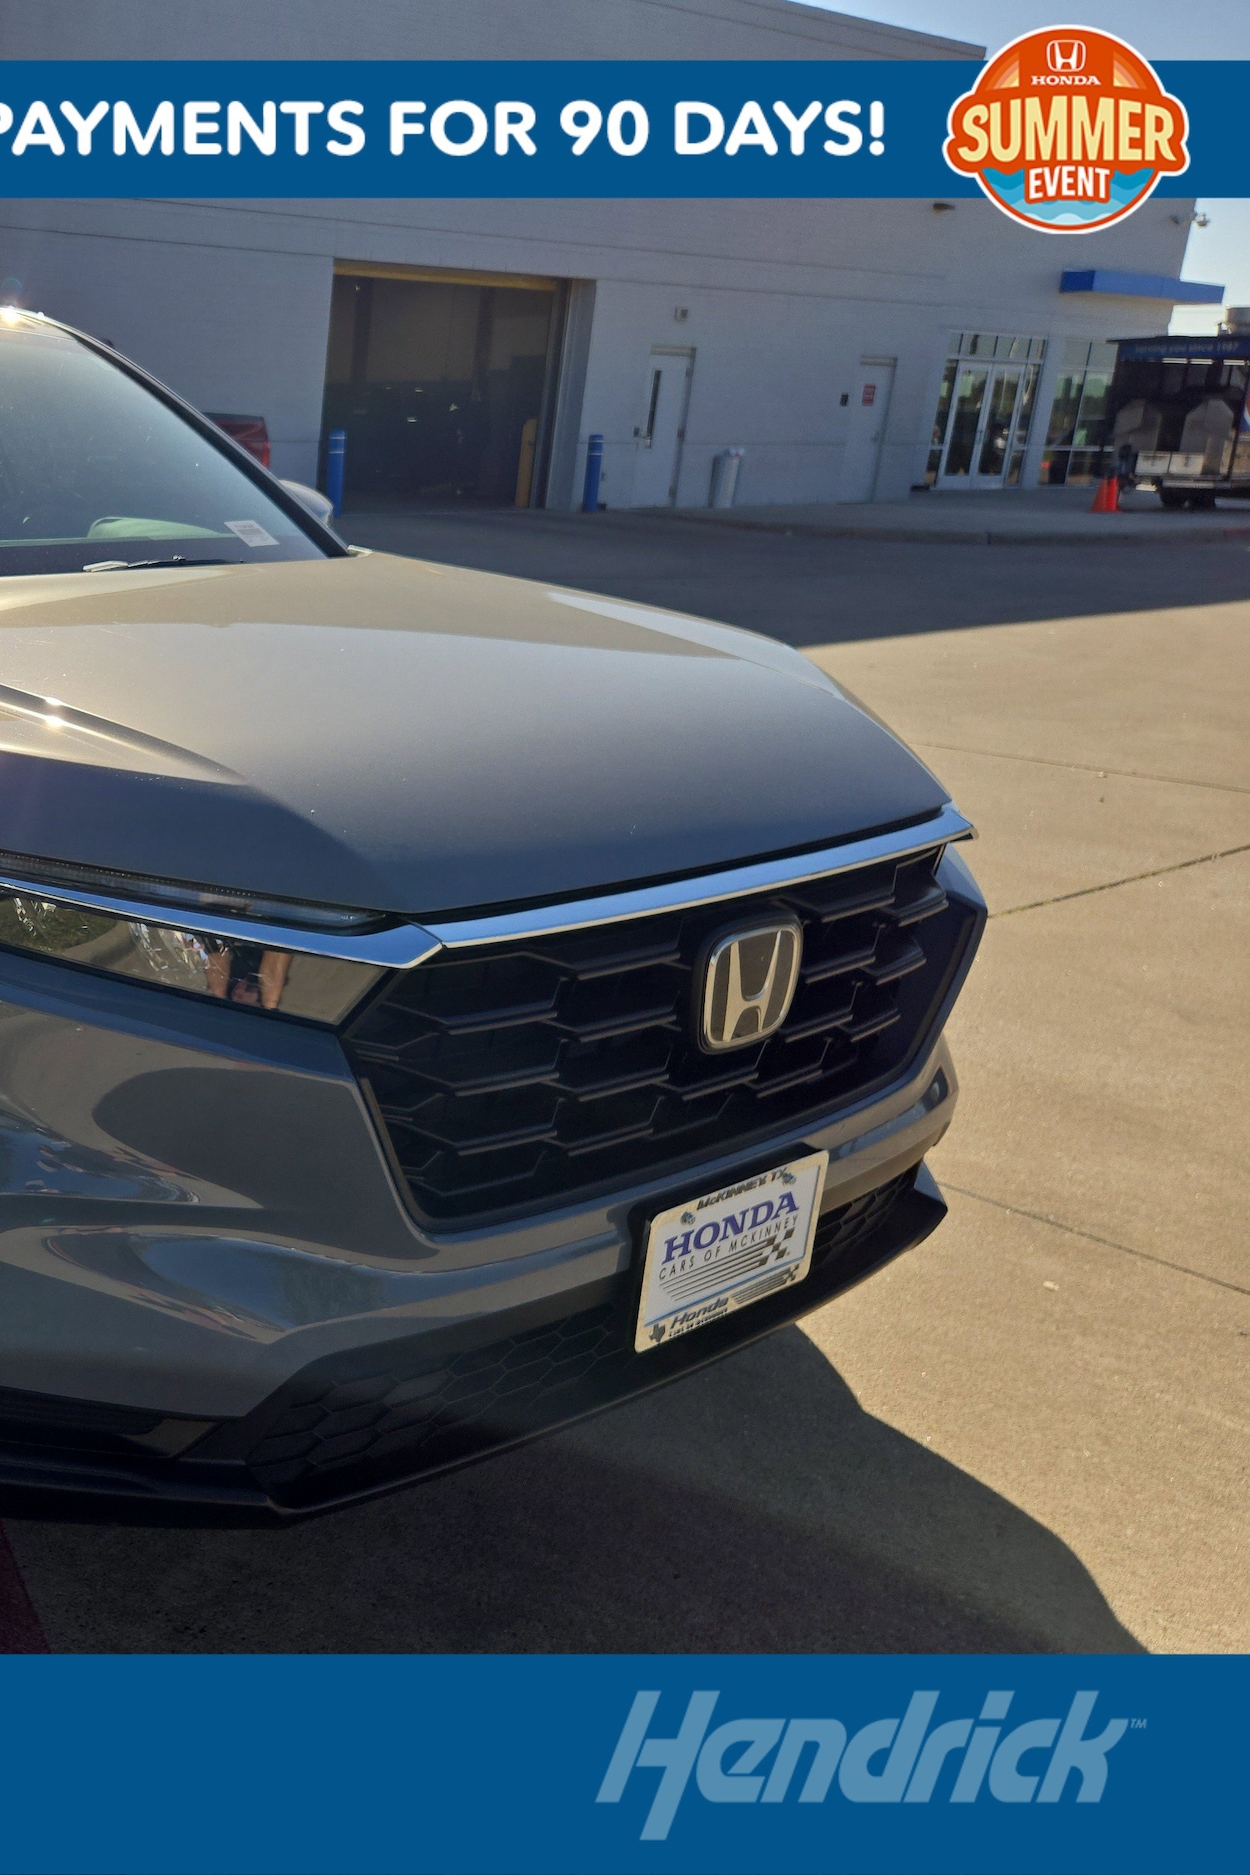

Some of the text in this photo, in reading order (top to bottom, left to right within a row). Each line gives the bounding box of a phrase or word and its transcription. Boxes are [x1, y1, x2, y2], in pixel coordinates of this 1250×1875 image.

[658, 1215, 799, 1280] CARS OF MCKINNEY
[661, 1191, 799, 1265] HONDA
[670, 1297, 729, 1329] Honda
